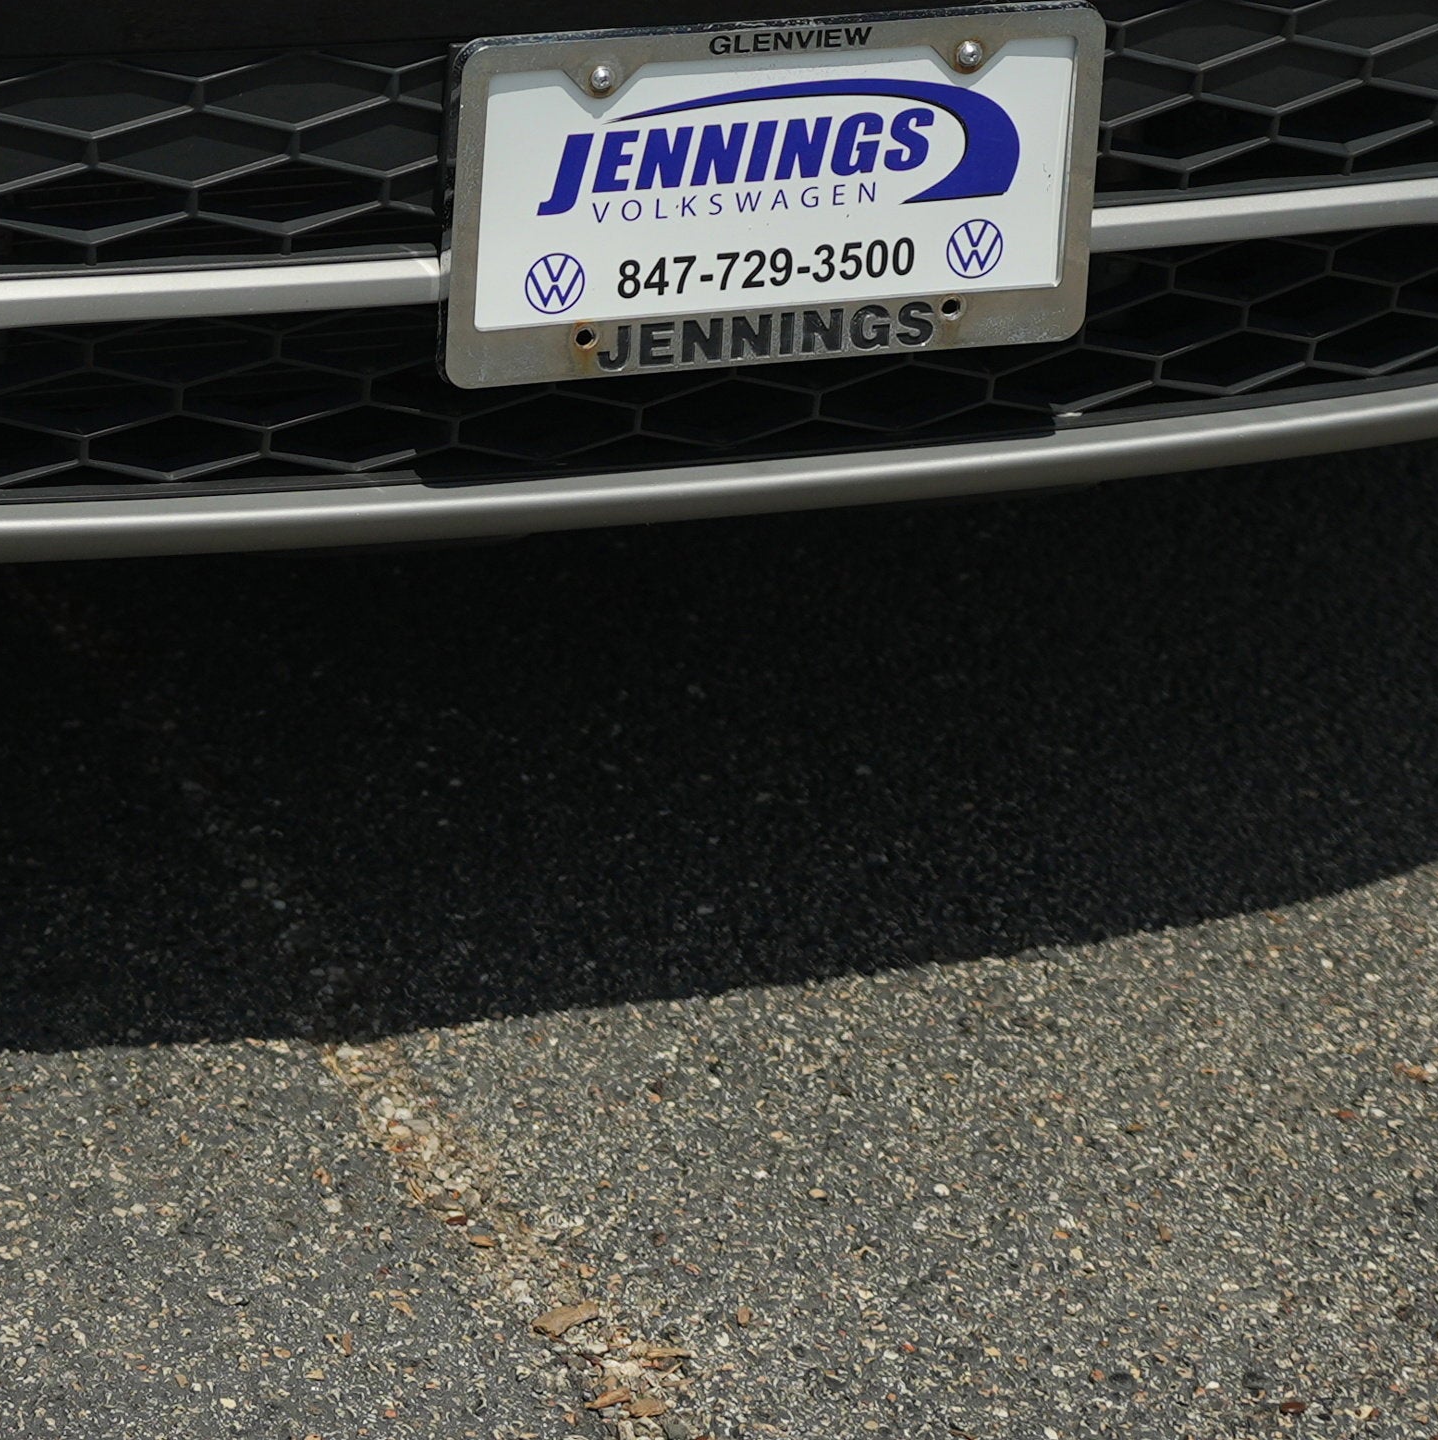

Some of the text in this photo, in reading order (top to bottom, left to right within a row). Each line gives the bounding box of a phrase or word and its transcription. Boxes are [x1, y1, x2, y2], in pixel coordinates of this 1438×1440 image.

[708, 25, 873, 57] GLENVIEW
[536, 107, 934, 216] JENNINGS
[592, 180, 879, 224] VOLKSWAGEN
[616, 236, 916, 300] 847-729-3500
[596, 300, 935, 372] JENNINGS
